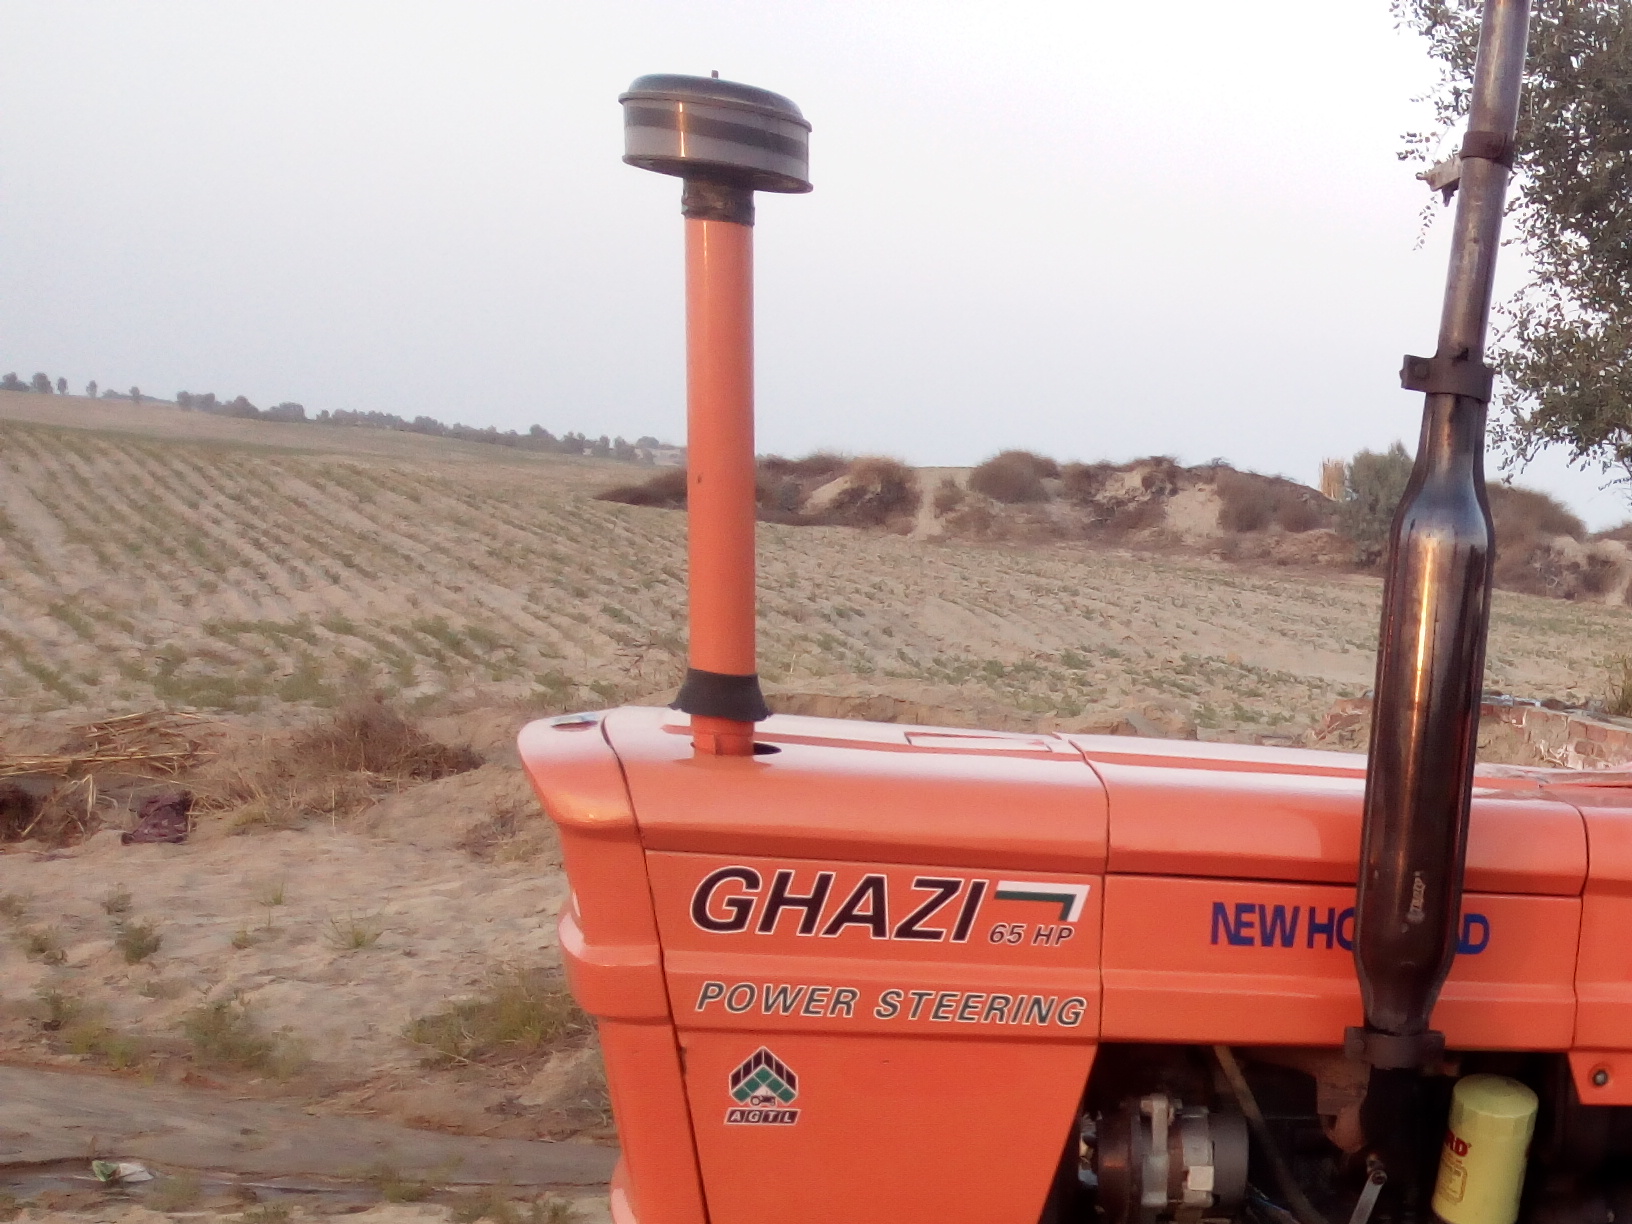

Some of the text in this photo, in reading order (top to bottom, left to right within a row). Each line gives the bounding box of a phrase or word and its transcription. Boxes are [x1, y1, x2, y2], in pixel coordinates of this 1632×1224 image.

[690, 865, 989, 943] GHAZI
[1210, 901, 1300, 948] NEW
[989, 923, 1074, 947] 65 HP
[696, 981, 1087, 1027] POWER STEERING
[728, 1109, 796, 1124] AGTL
